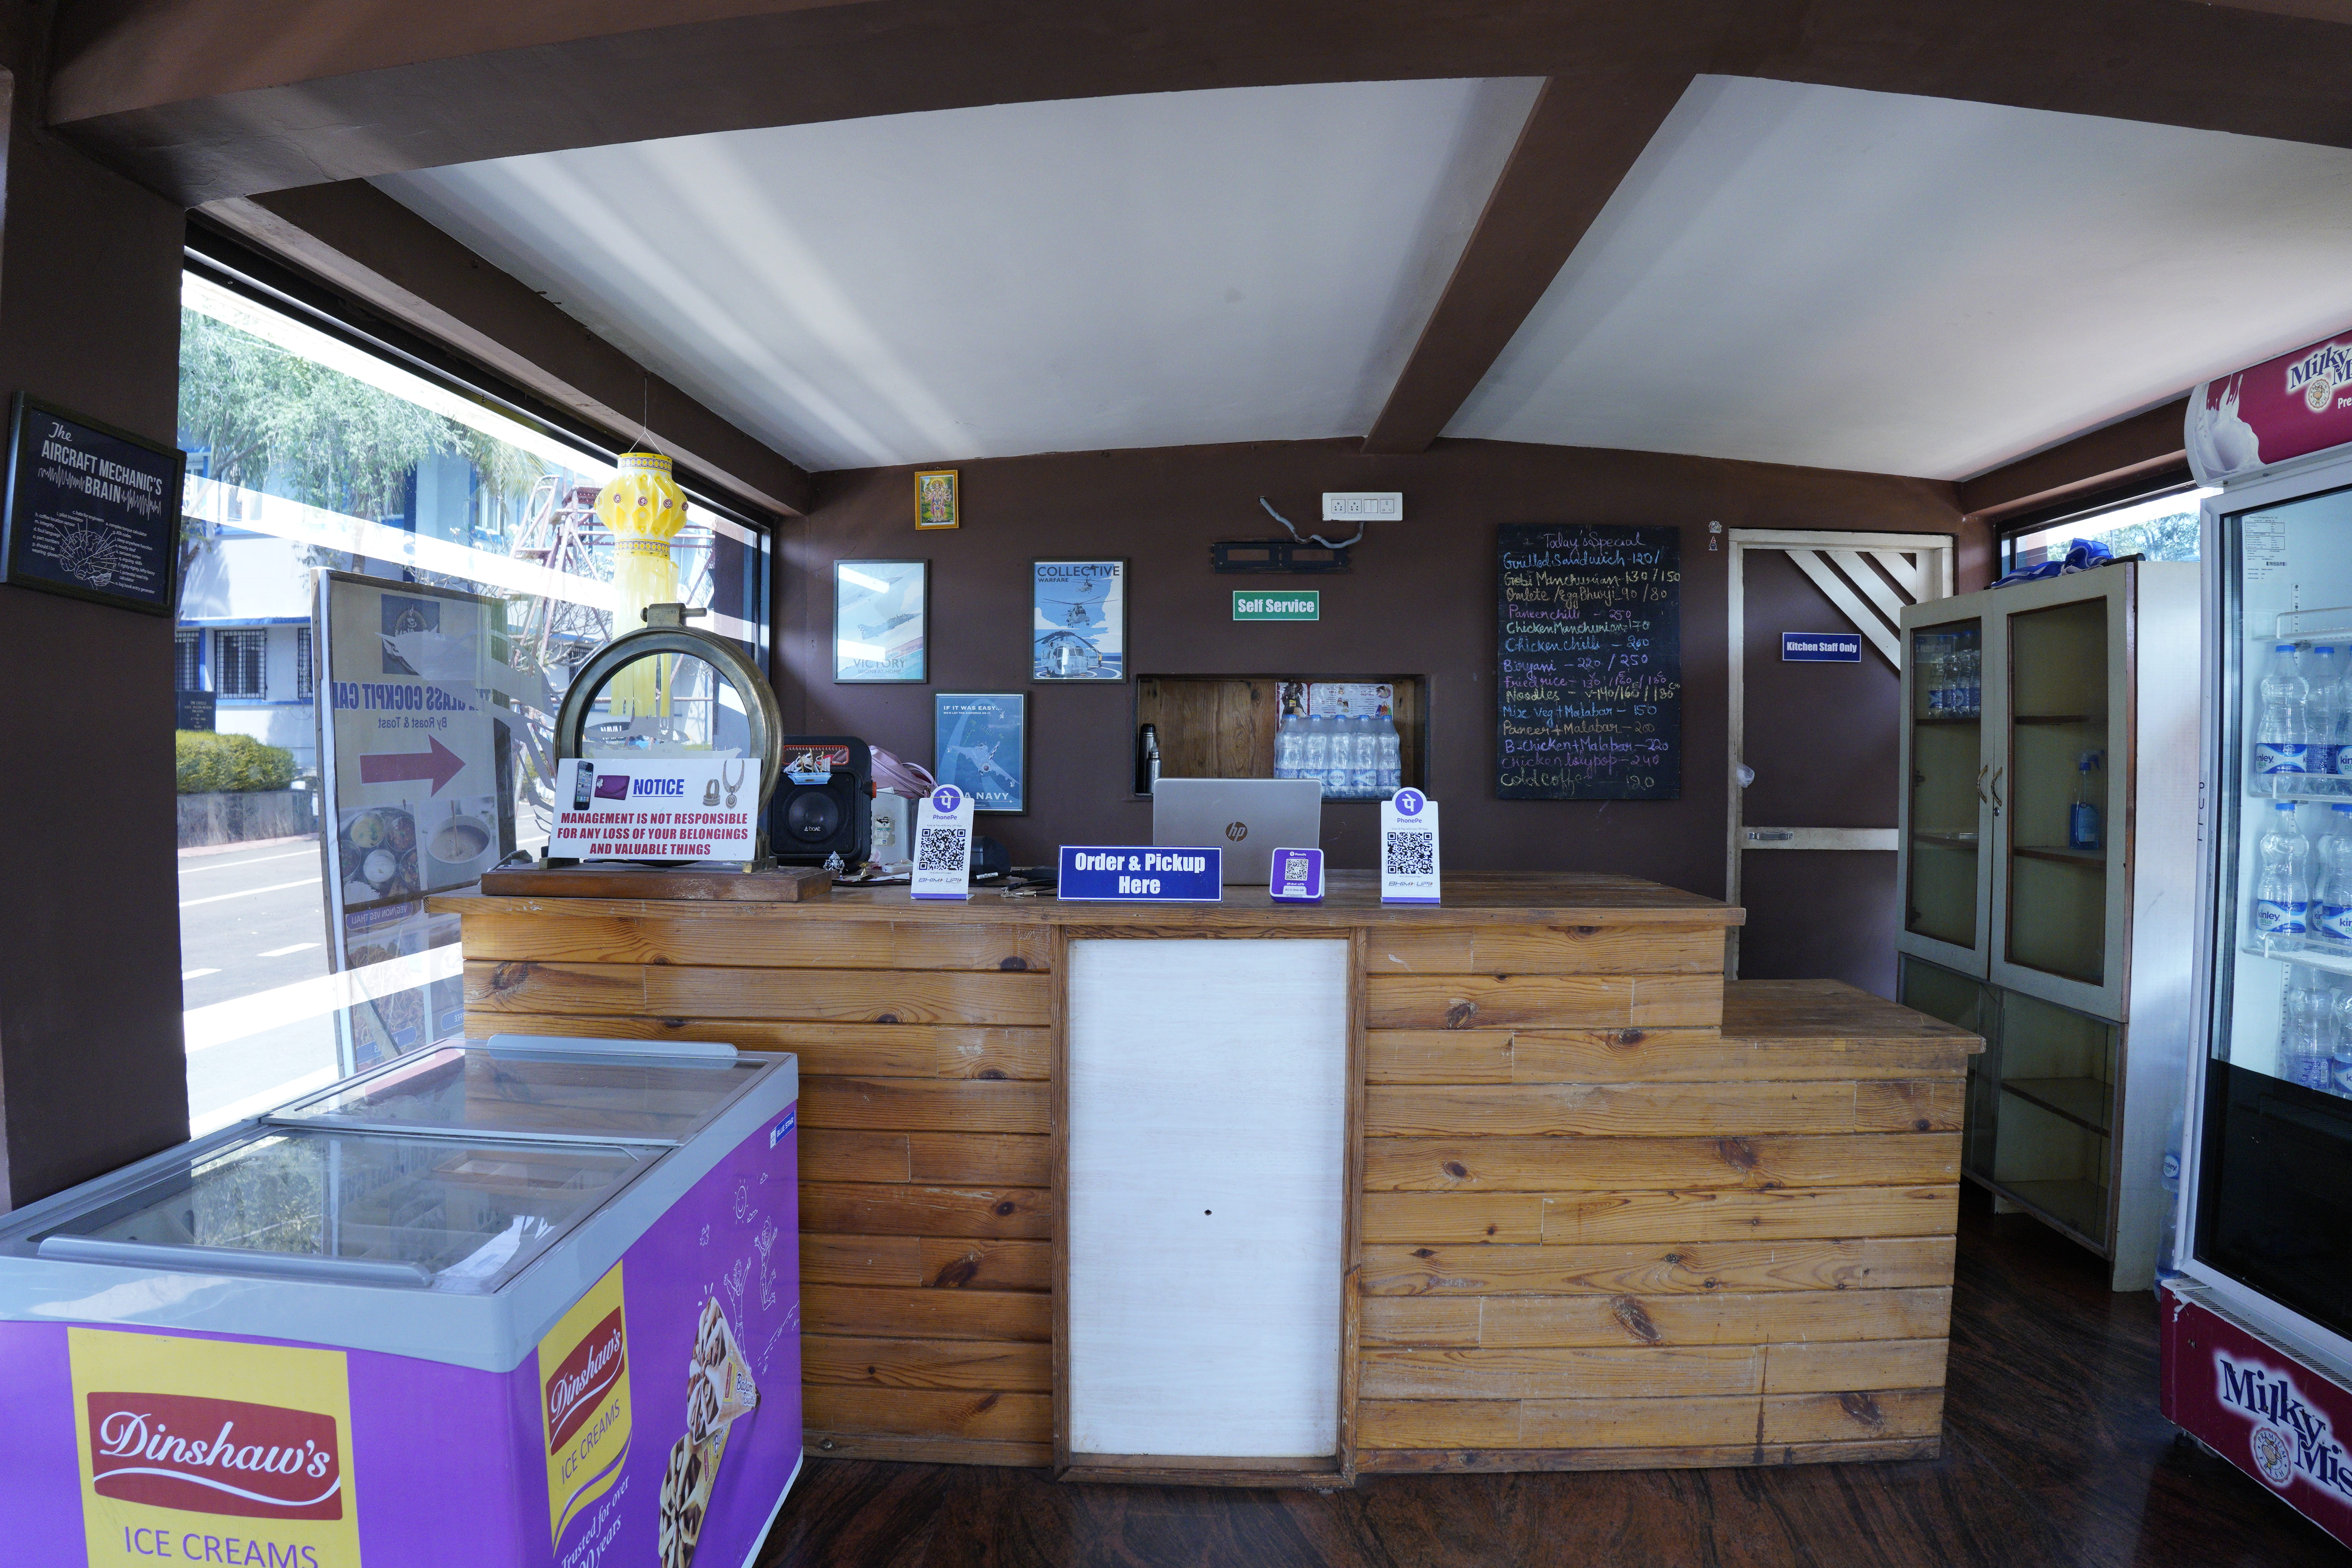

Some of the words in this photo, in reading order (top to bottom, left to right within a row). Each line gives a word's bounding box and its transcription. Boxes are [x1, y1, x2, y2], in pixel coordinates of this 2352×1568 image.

[2290, 346, 2352, 389] Milky
[49, 422, 73, 441] The
[41, 440, 98, 474] AIRCRAFT
[99, 459, 162, 495] MECHANIC'S
[84, 475, 121, 503] BRAIN
[1037, 566, 1120, 577] COLLECTIVE
[1238, 599, 1263, 613] Self
[1265, 599, 1314, 613] Service
[1786, 642, 1818, 652] Kitchen
[1819, 643, 1838, 652] Staff
[1839, 644, 1857, 654] Only
[853, 659, 907, 668] VICTORY
[633, 779, 684, 795] NOTICE
[561, 813, 634, 824] MANAGEMENT
[636, 813, 648, 824] IS
[650, 813, 672, 824] NOT
[674, 813, 748, 824] RESPONSIBLE
[557, 828, 577, 838] FOR
[579, 828, 601, 839] ANY
[603, 828, 630, 839] LOSS
[632, 828, 646, 839] OF
[648, 828, 677, 840] YOUR
[679, 828, 748, 840] BELONGINGS
[1228, 823, 1245, 841] hp
[590, 843, 612, 854] AND
[615, 843, 667, 855] VALUABLE
[670, 844, 711, 855] THINGS
[1074, 853, 1124, 871] Order
[1128, 855, 1142, 871] &
[1145, 853, 1205, 873] Pickup
[1118, 875, 1161, 895] Here
[2258, 909, 2281, 922] kinley
[777, 1124, 785, 1138] BLUE
[785, 1116, 794, 1130] STAR
[551, 1328, 621, 1417] Dinshaw's
[2219, 1359, 2327, 1450] Milky
[100, 1411, 330, 1478] Dinshaw's
[561, 1450, 578, 1485] ICE
[580, 1399, 620, 1460] CREAMS
[561, 1516, 596, 1568] Trusted
[596, 1502, 611, 1538] for
[612, 1475, 630, 1507] over
[125, 1526, 172, 1557] ICE
[182, 1533, 319, 1568] CREAMS
[596, 1514, 621, 1568] years
